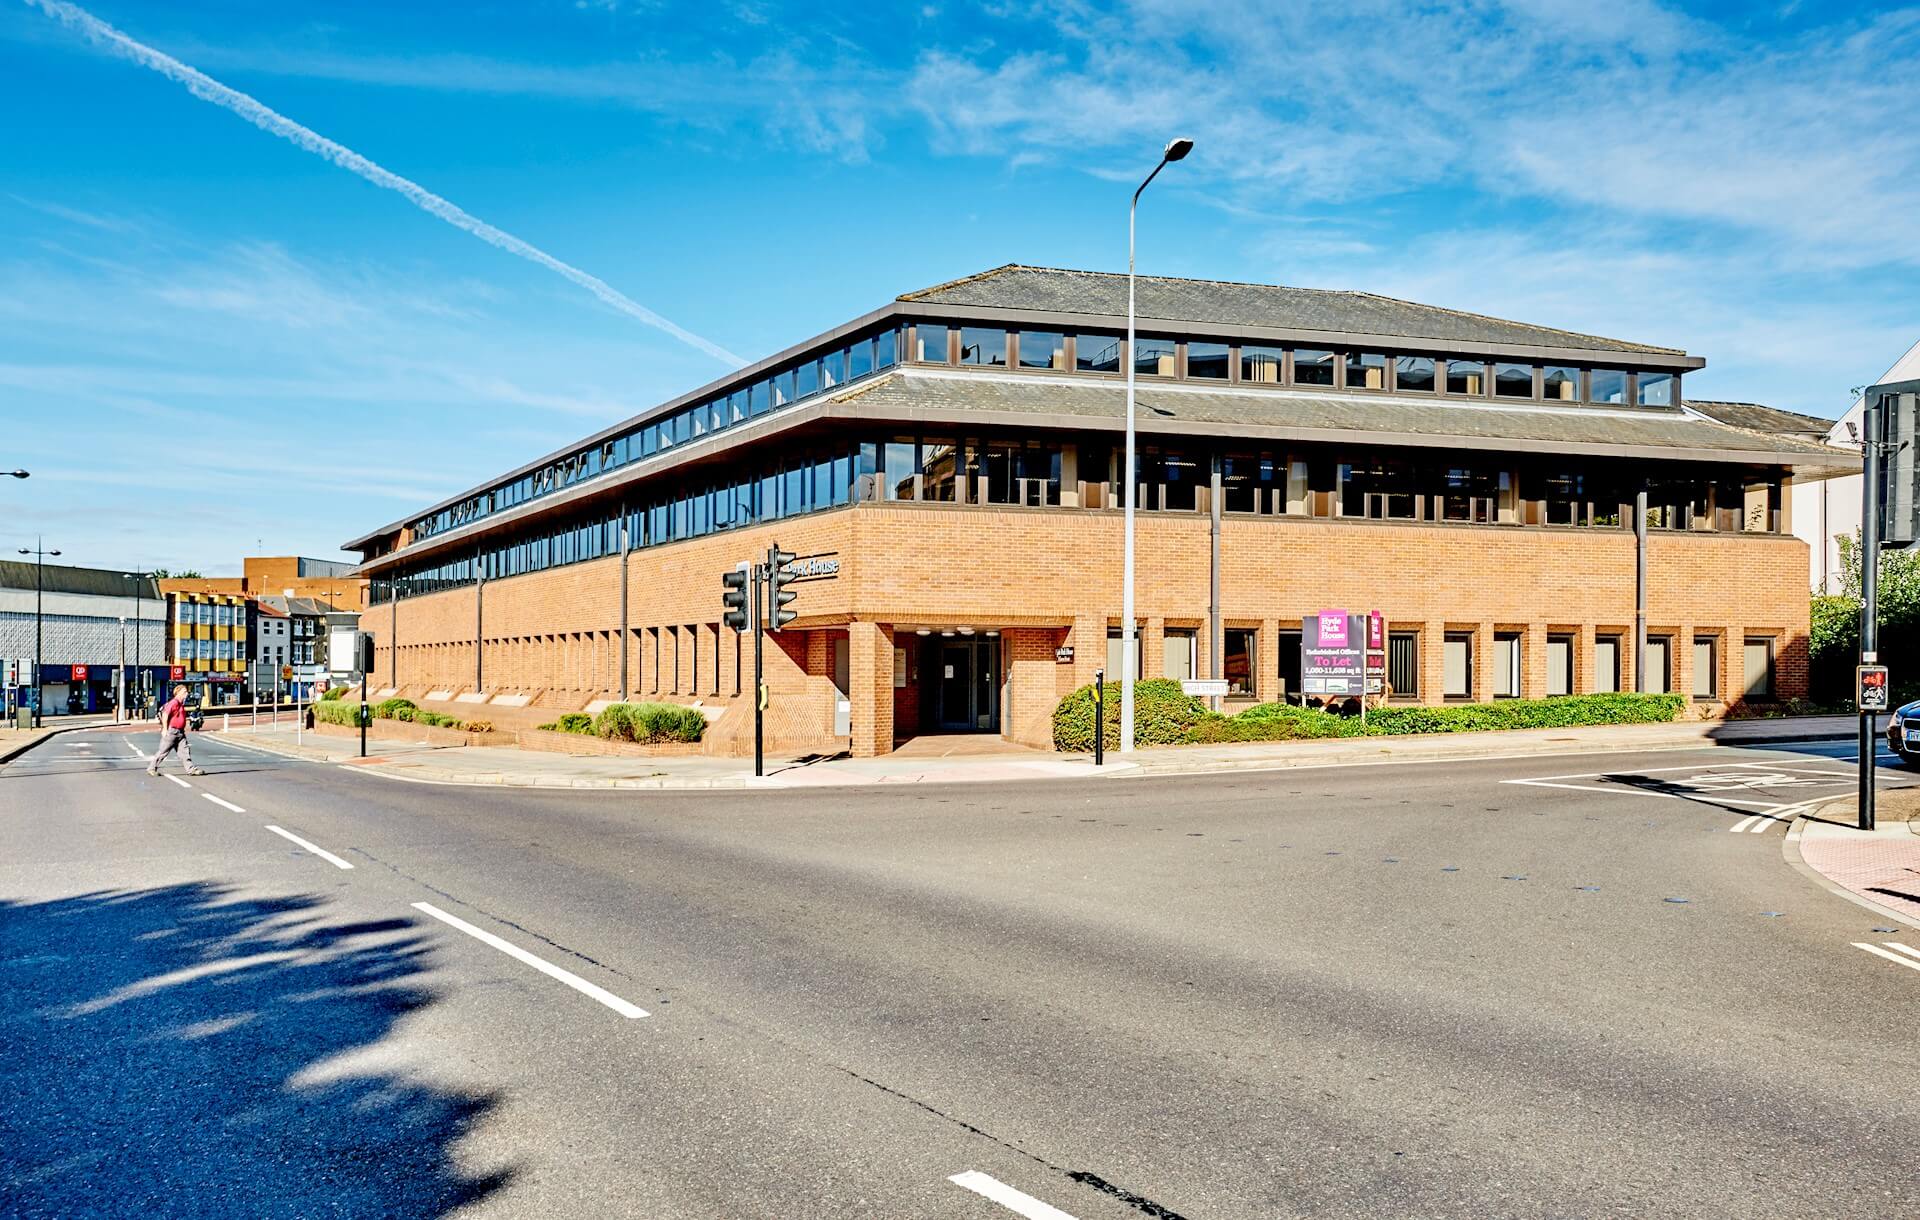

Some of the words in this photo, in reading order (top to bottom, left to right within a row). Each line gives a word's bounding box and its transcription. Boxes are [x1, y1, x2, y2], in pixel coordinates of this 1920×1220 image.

[809, 558, 839, 575] House
[1322, 617, 1342, 627] Hyde
[1321, 624, 1340, 632] Park
[1321, 631, 1345, 639] House
[1315, 656, 1330, 666] To
[1331, 656, 1351, 666] Let
